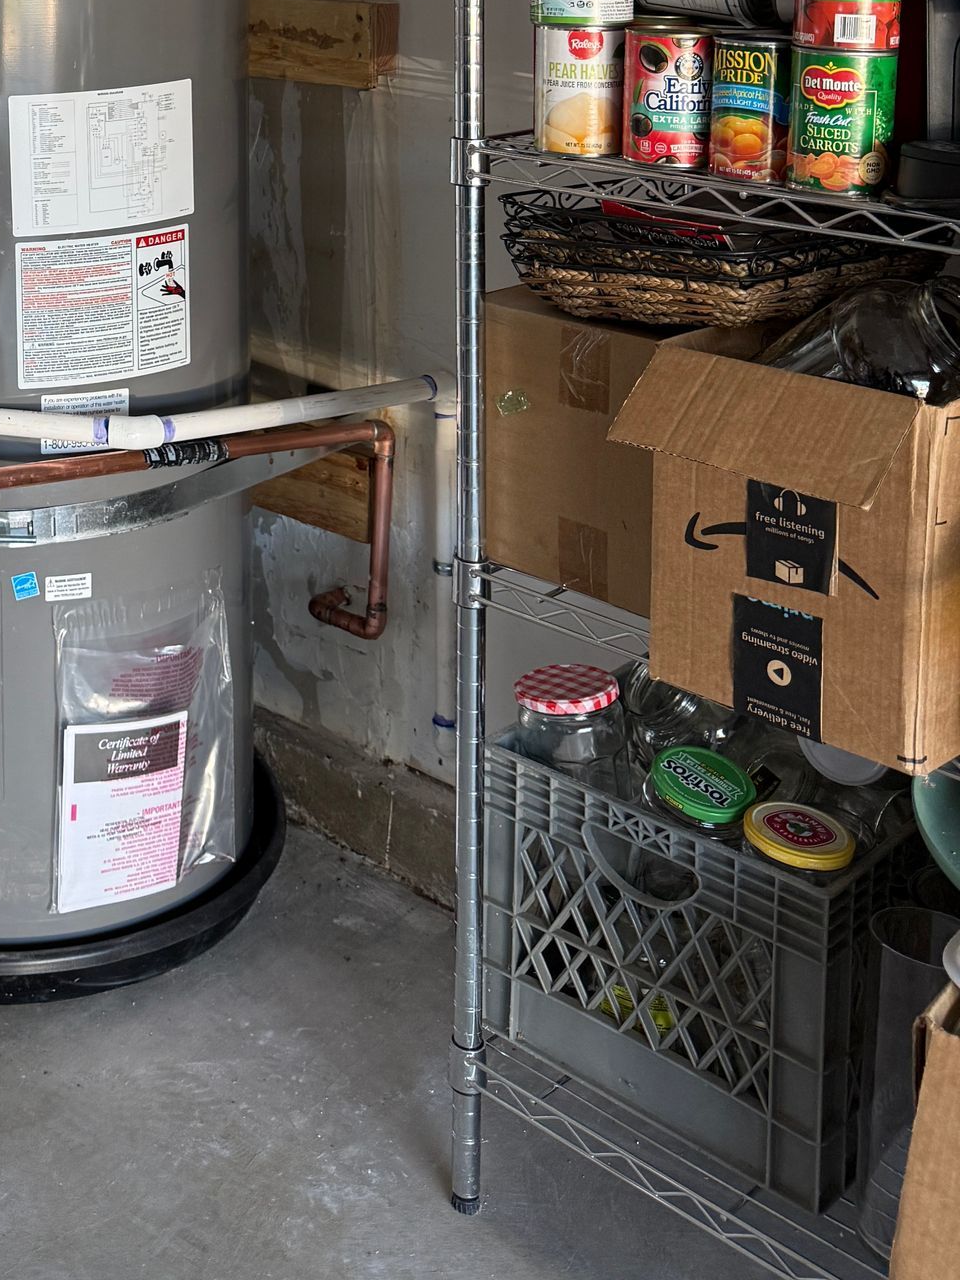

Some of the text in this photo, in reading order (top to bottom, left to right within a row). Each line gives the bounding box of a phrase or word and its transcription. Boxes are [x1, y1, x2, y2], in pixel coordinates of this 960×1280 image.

[548, 61, 619, 81] PEAR HALVES
[714, 48, 778, 79] MISSION
[720, 69, 763, 84] PRIDE
[805, 75, 861, 92] Del Monte
[733, 87, 755, 100] Apricot
[817, 91, 842, 102] Quality
[653, 115, 687, 124] EXTRA
[806, 123, 851, 140] SLICED
[800, 134, 858, 153] CARROTS
[148, 232, 183, 246] DANGER
[755, 511, 825, 540] free listening
[765, 526, 815, 544] millions songs
[741, 631, 818, 666] video streaming
[747, 704, 811, 736] free delivery
[99, 733, 148, 750] Certificate
[111, 748, 148, 762] Limited
[106, 758, 151, 774] Warranty
[661, 758, 730, 807] TOSTITOS
